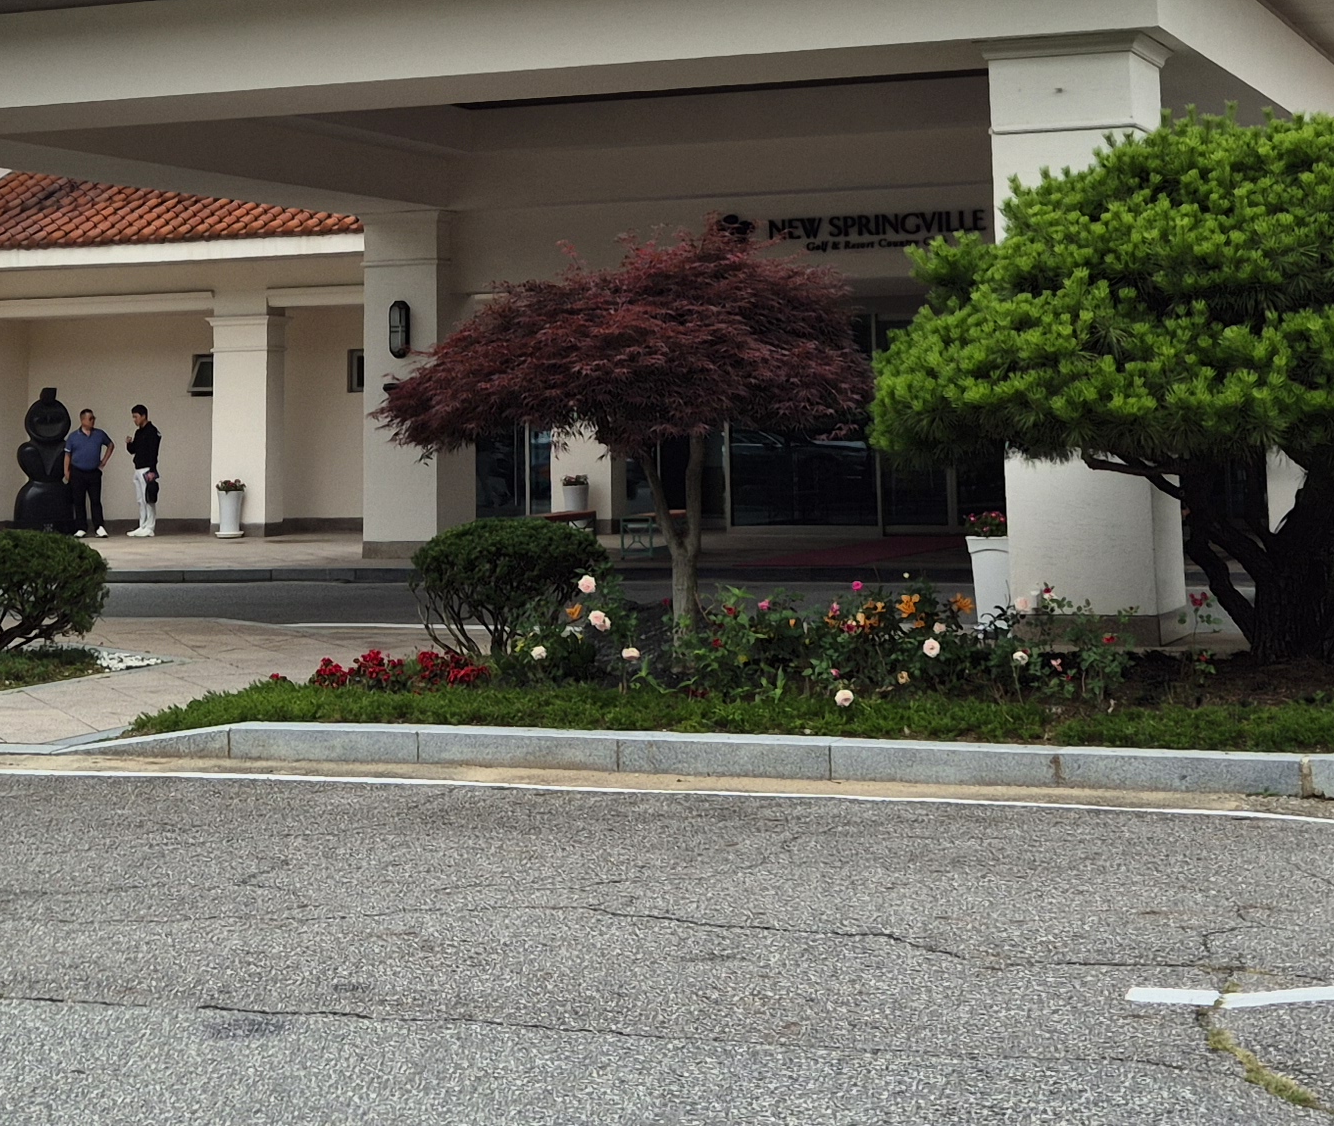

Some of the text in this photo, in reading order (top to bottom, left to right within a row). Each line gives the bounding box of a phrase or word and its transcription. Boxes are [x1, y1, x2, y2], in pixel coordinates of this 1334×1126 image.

[768, 210, 986, 240] NEW SPRINGVILLE
[806, 241, 829, 252] Golf
[831, 241, 840, 250] &
[844, 241, 874, 250] Resort
